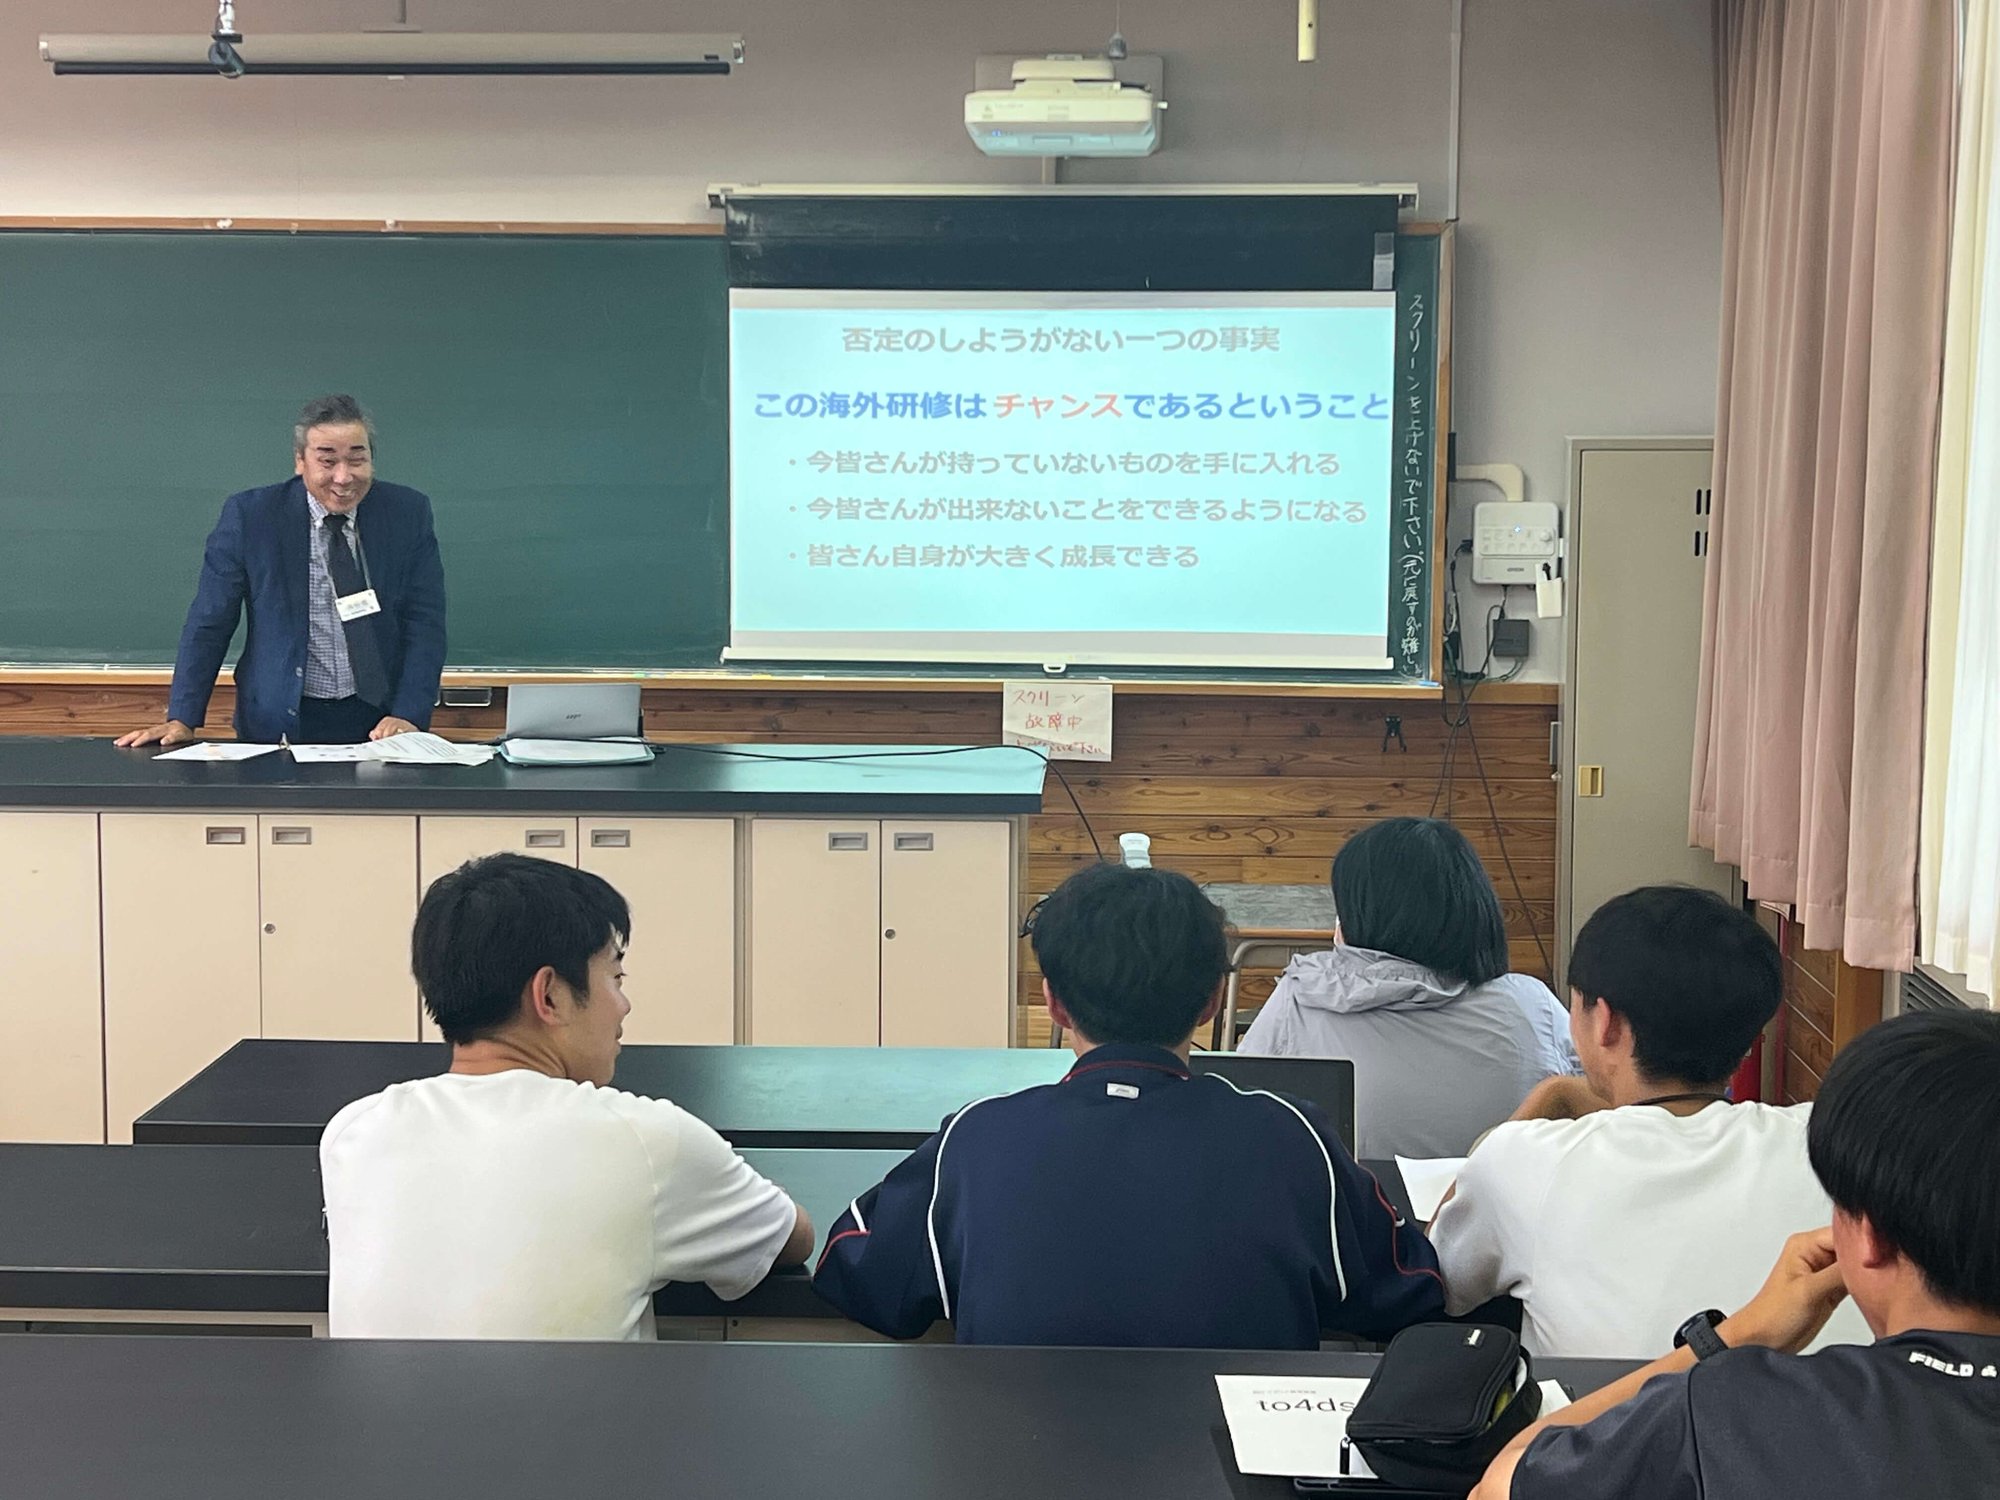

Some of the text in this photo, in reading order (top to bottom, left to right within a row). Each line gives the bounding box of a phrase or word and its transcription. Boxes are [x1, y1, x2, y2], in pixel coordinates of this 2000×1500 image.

[841, 326, 1281, 353] 否定のしようがない一つの事実
[1012, 689, 1085, 707] スクリーン
[1025, 711, 1083, 731] 故障中
[1909, 1351, 1974, 1377] FIELD
